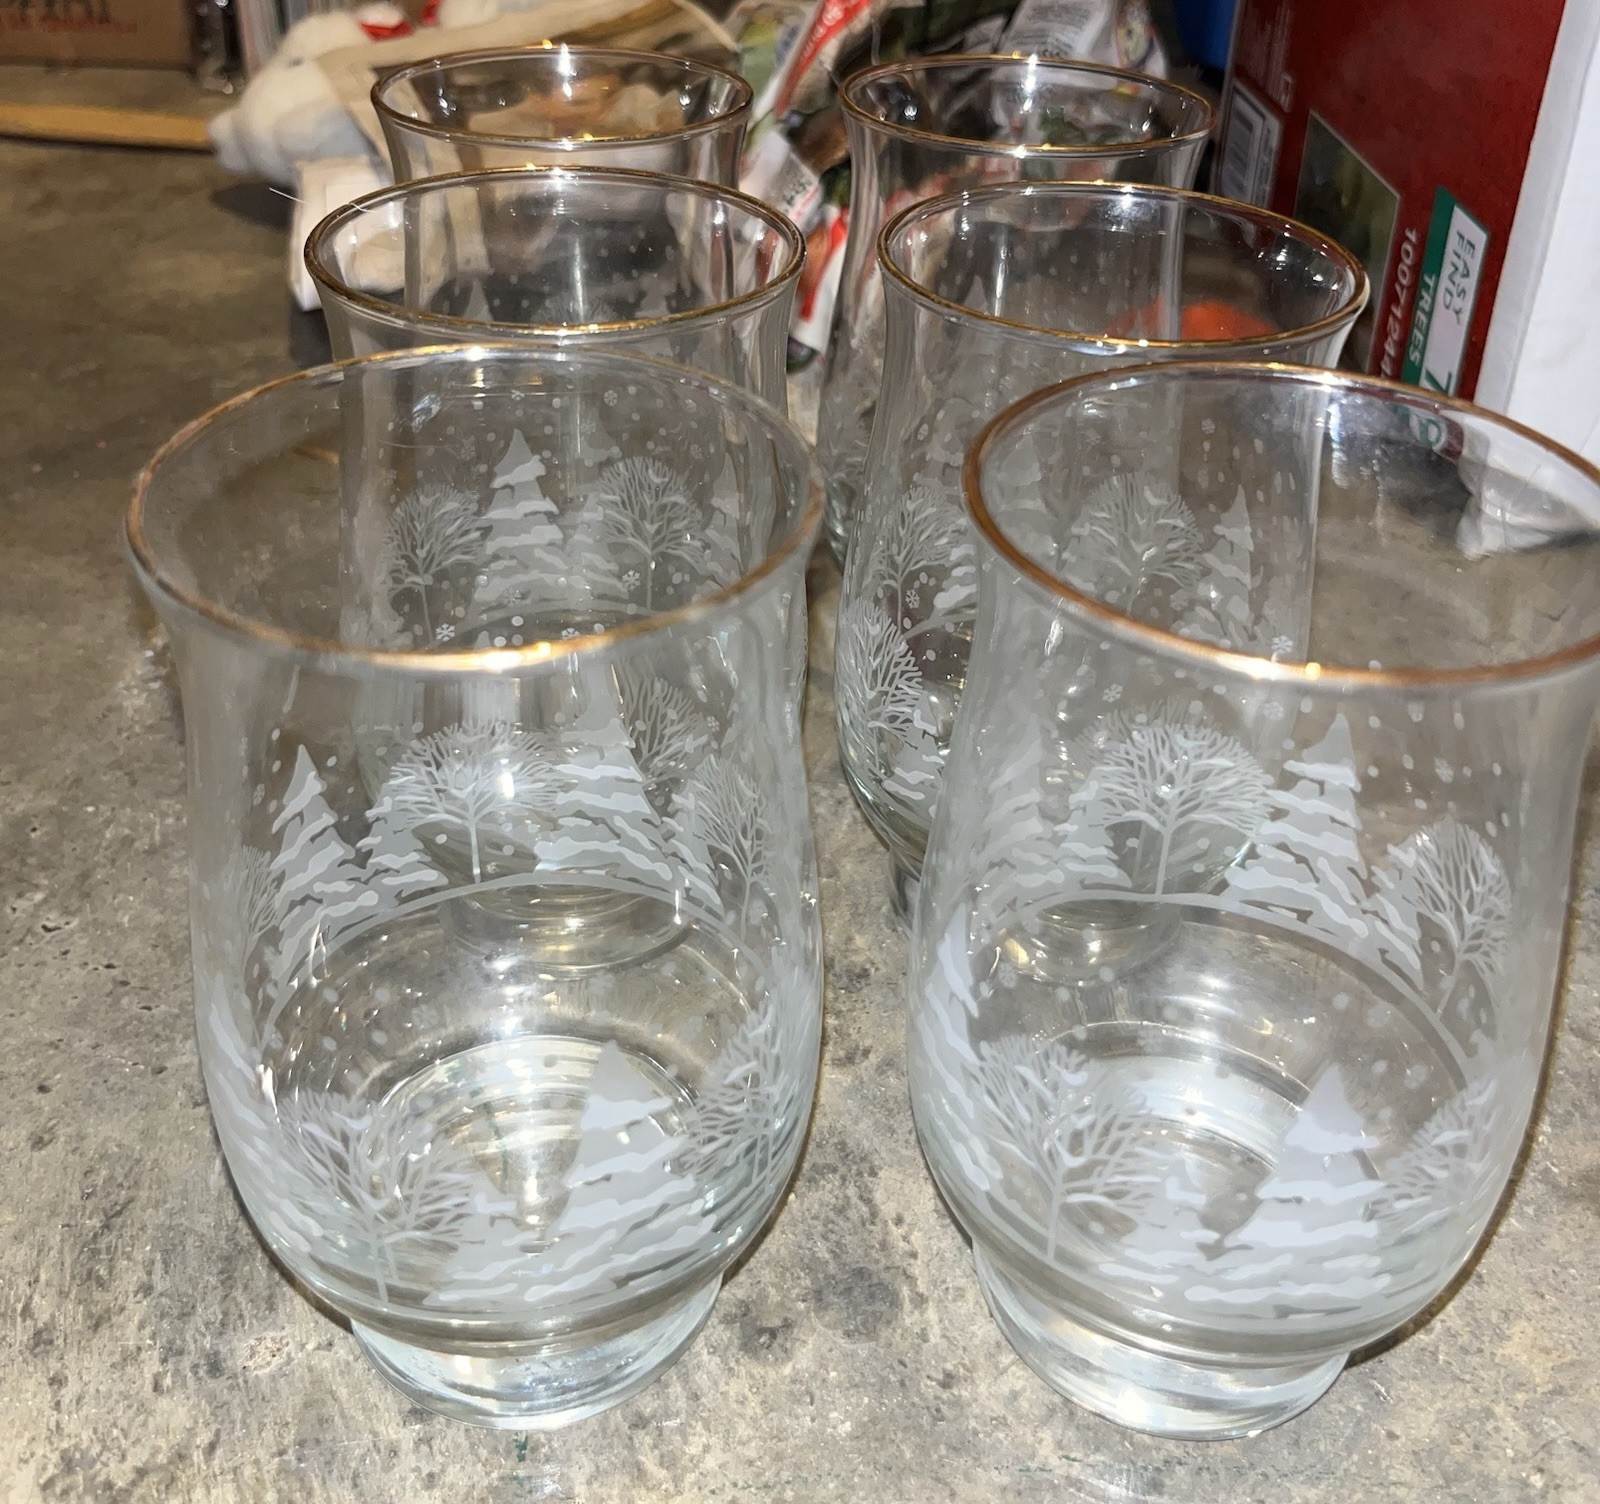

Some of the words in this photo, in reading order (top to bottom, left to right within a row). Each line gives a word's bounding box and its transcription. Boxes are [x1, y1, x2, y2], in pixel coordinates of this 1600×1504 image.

[1380, 226, 1418, 379] 10071244
[1443, 229, 1467, 311] FIND
[1452, 239, 1476, 326] EASY
[1408, 272, 1437, 367] TREES
